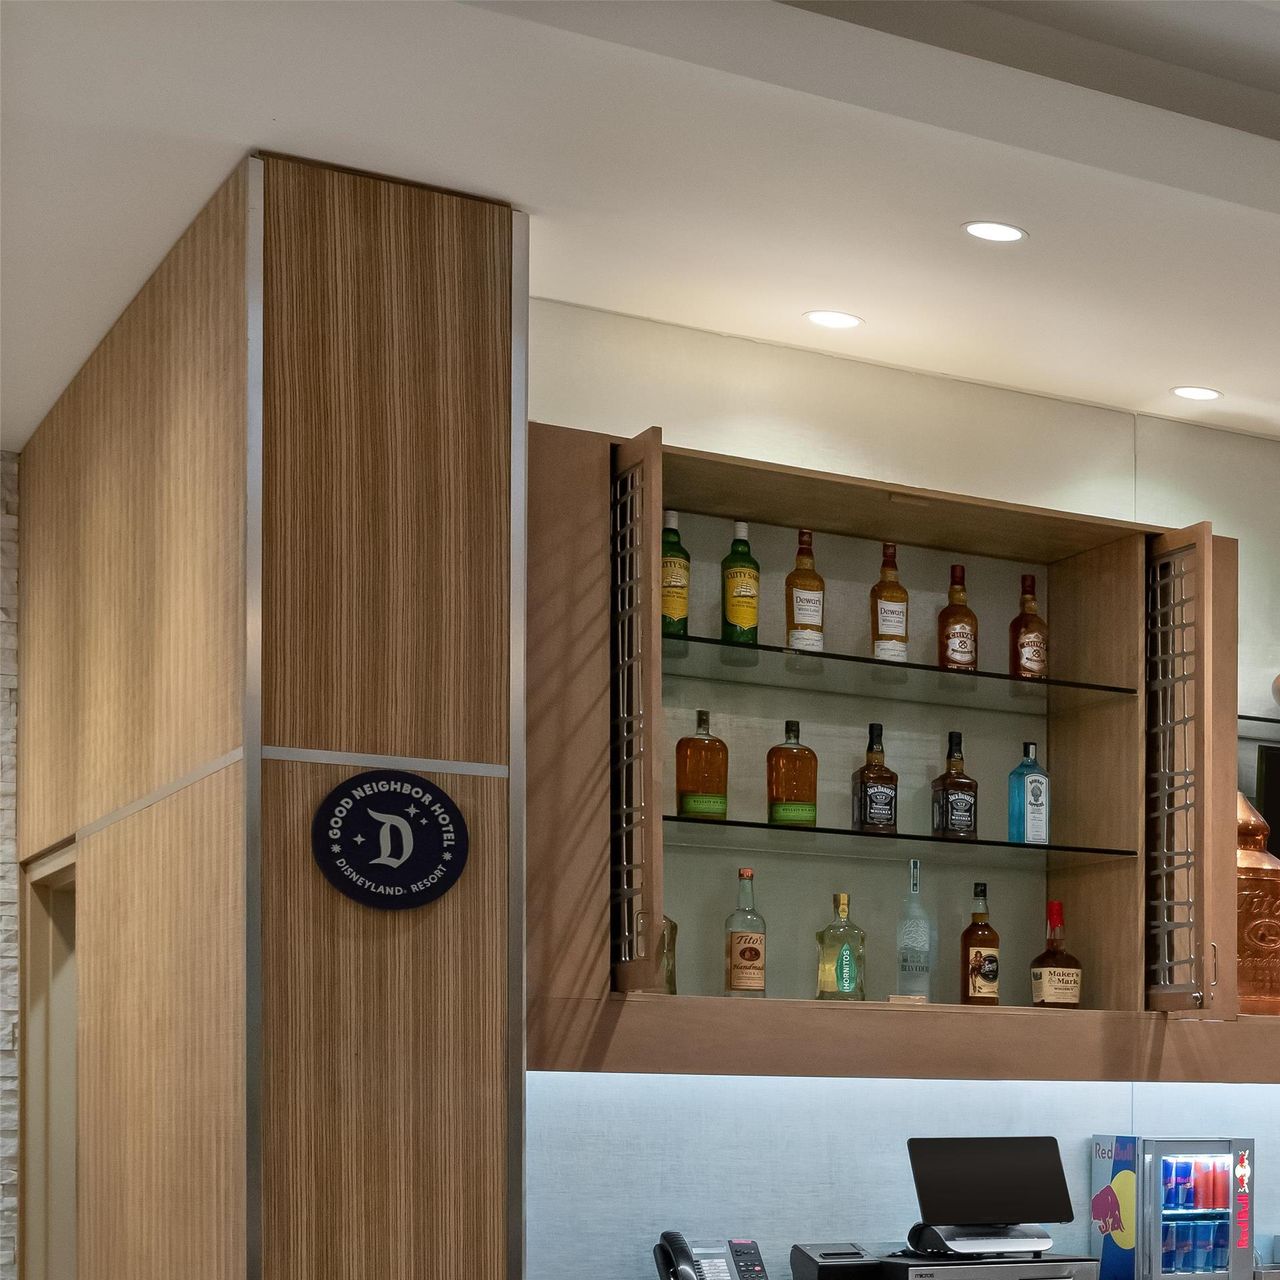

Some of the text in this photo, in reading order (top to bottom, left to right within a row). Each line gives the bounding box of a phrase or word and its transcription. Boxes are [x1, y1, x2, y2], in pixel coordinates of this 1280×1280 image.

[328, 781, 455, 848] GOOD NEIGHBOR HOTEL
[410, 863, 447, 893] RESORT
[736, 934, 763, 945] Tito's
[842, 949, 850, 993] HORNITOS
[1048, 970, 1080, 978] Maker's
[1057, 977, 1079, 985] Mark
[1094, 1142, 1113, 1161] Red
[1236, 1194, 1249, 1249] Red Bull
